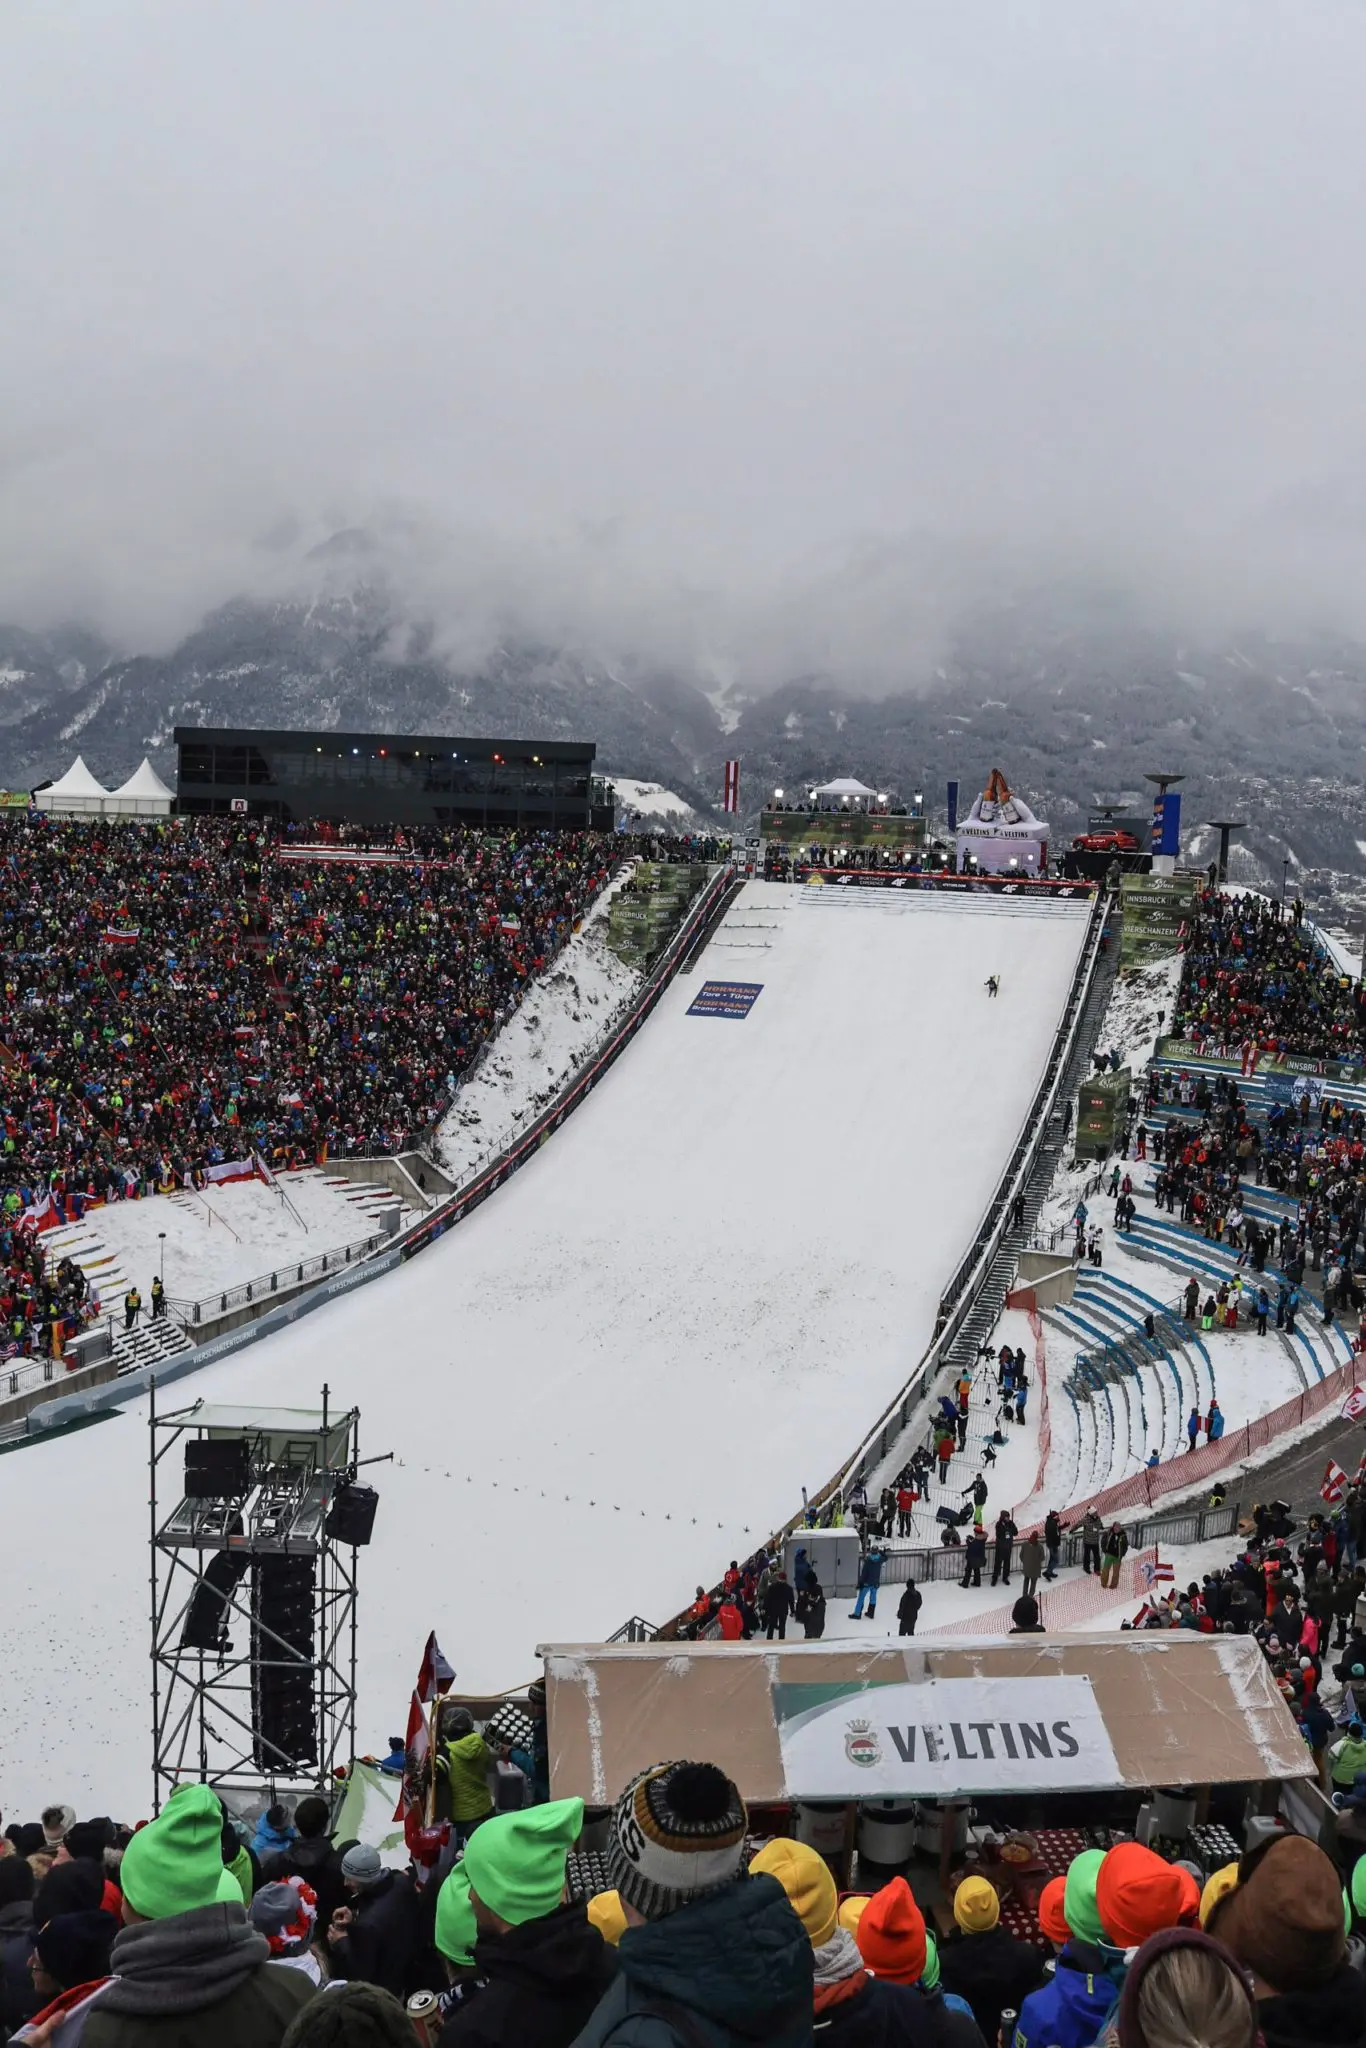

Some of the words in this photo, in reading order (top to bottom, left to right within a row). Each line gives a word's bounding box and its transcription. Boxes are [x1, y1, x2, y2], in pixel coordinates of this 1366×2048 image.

[837, 875, 853, 884] 4F
[891, 877, 907, 887] 4F
[1002, 884, 1018, 893] 4F
[1058, 887, 1074, 896] 4F
[1127, 895, 1166, 904] INNSBRUCK
[614, 911, 648, 920] INNSBRUCK
[453, 1205, 465, 1221] 4F
[327, 1258, 391, 1294] VIERSCHANZENTOURNEE
[192, 1327, 257, 1364] VIERSCHANZENTOURNEE
[886, 1720, 1080, 1763] VELTINS
